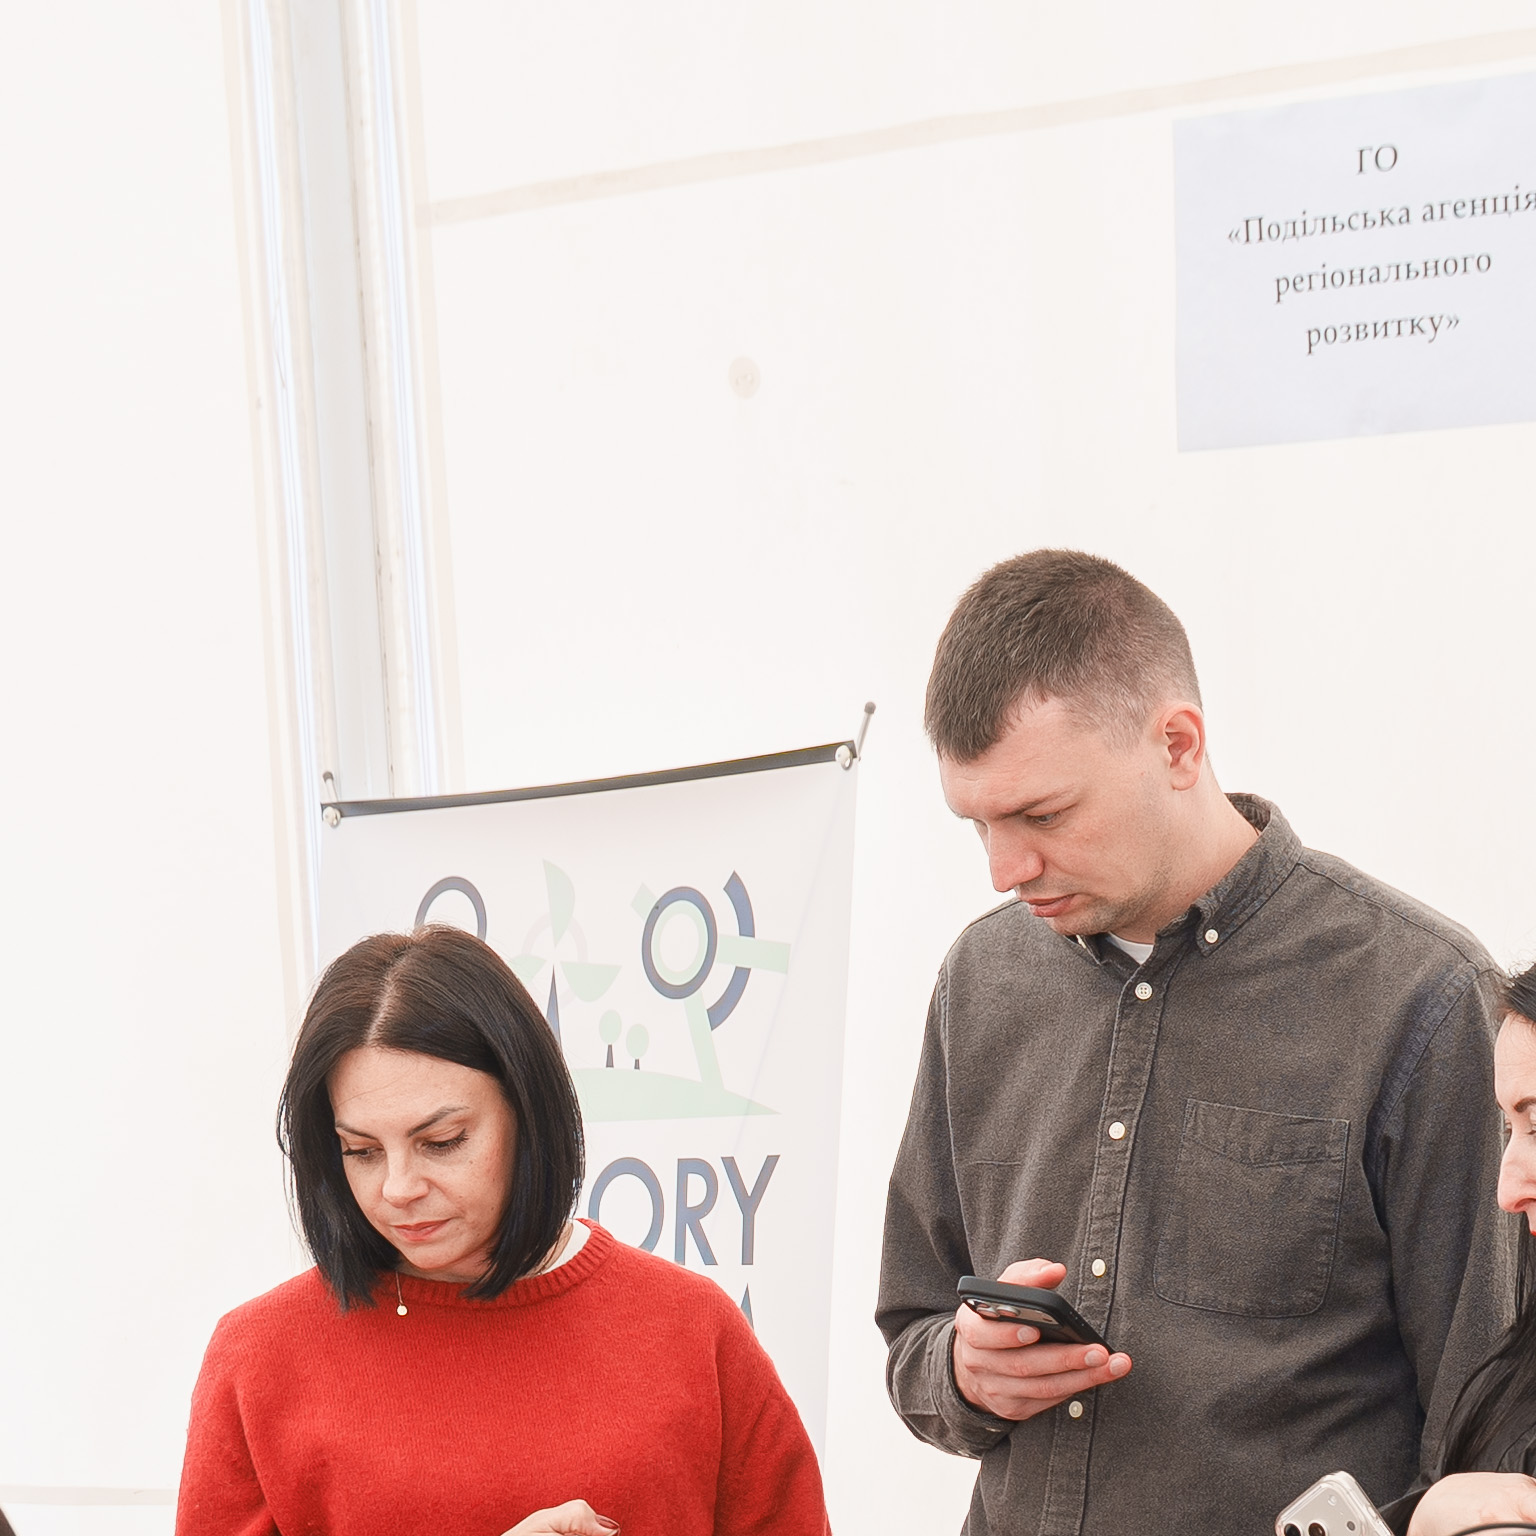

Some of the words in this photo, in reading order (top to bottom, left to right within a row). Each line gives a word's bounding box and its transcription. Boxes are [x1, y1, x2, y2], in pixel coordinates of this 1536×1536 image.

[1356, 143, 1399, 175] ГО
[1228, 205, 1410, 245] «Подільська
[1275, 253, 1492, 304] регіонального
[1306, 312, 1460, 354] розвитку»
